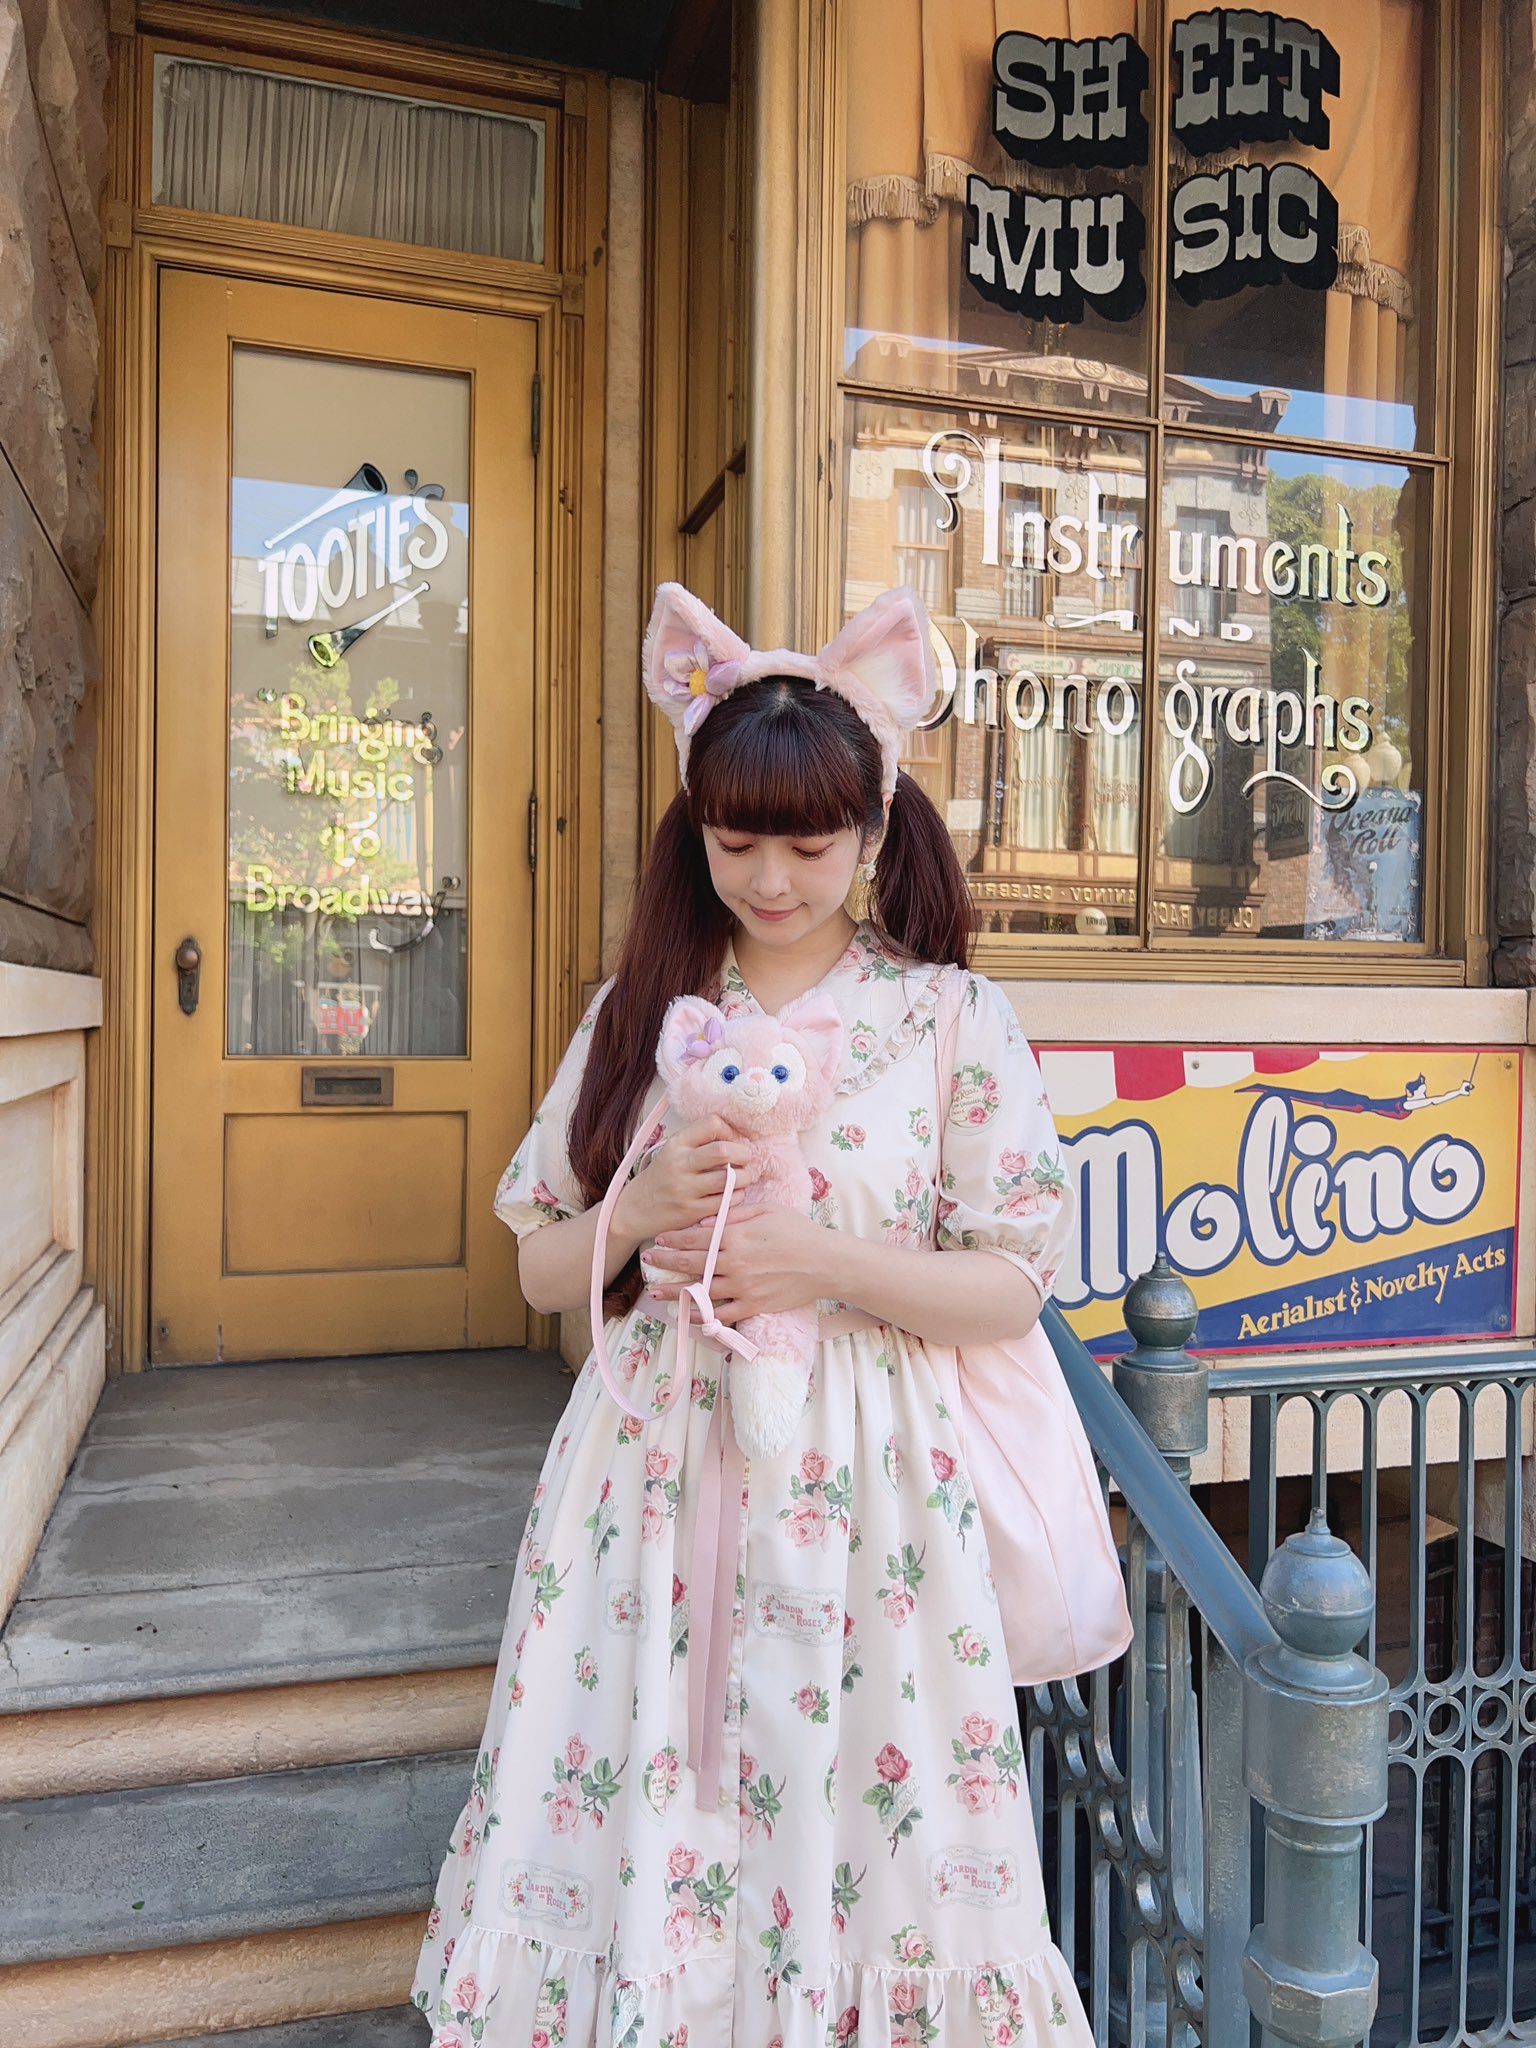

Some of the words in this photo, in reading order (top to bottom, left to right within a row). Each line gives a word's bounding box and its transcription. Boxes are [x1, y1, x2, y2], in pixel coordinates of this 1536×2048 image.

[994, 8, 1324, 142] SHEET
[968, 163, 1321, 298] MUSIC
[922, 429, 1391, 606] Instruments
[1044, 609, 1254, 641] AND
[281, 749, 415, 801] Music
[1350, 828, 1401, 855] Roll
[1052, 1095, 1485, 1308] Molino
[1237, 1287, 1347, 1340] Aerialist
[1350, 1277, 1362, 1315] &
[1364, 1262, 1450, 1304] Novelty
[1453, 1245, 1506, 1278] Acts
